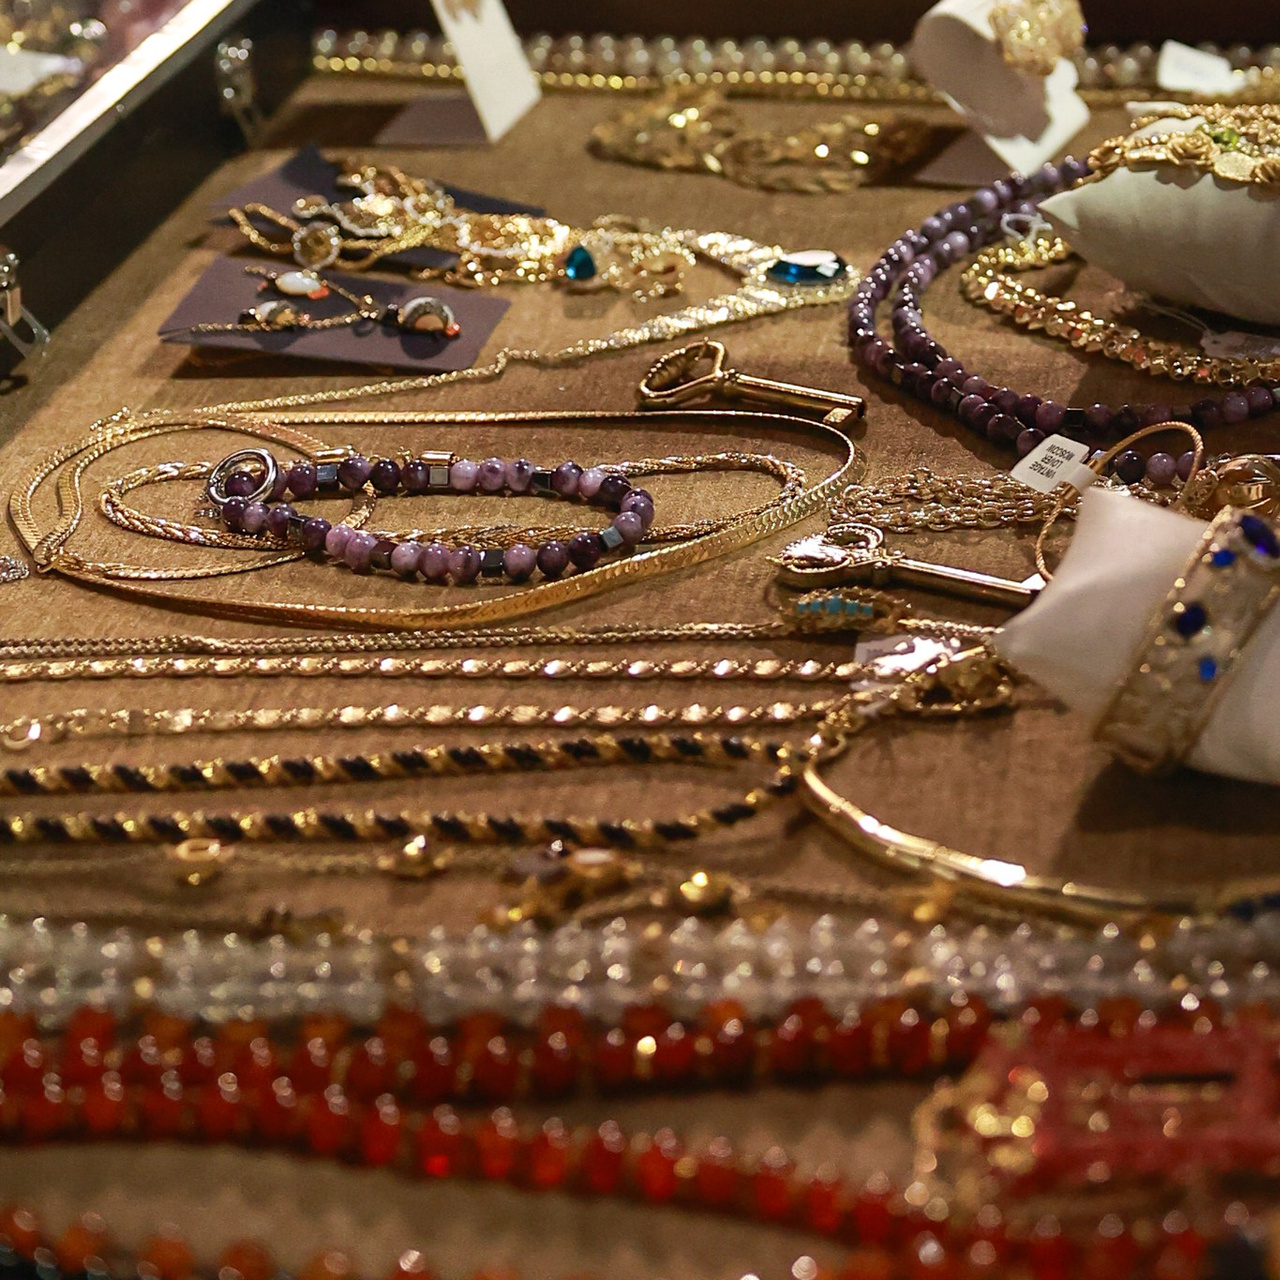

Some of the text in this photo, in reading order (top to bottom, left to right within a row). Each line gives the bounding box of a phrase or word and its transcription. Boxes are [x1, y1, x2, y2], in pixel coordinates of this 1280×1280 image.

[1046, 444, 1075, 461] MOSCOW
[1029, 461, 1056, 479] VINTAGE
[1041, 454, 1064, 469] LOVER
